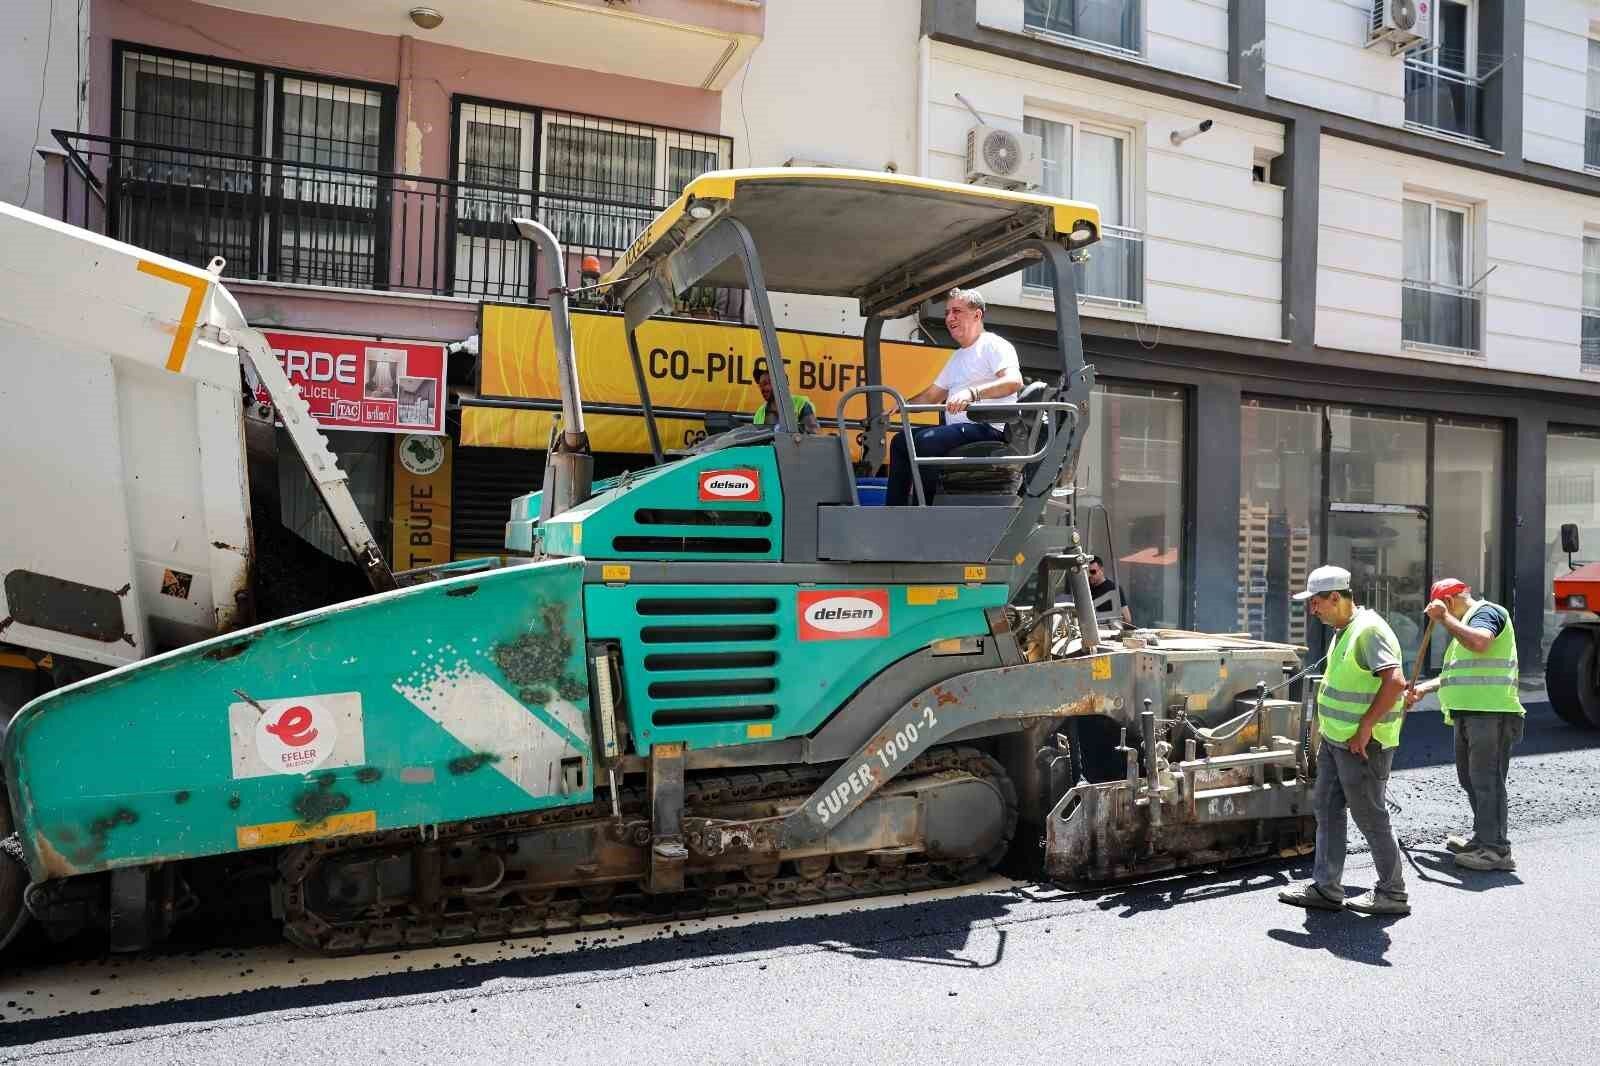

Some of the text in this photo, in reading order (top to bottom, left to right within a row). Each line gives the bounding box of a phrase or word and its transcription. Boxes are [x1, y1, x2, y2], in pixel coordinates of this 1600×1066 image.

[338, 405, 359, 417] TAC
[709, 480, 749, 490] delsan
[404, 485, 433, 546] BÜFE
[813, 607, 874, 621] delsan
[281, 749, 317, 762] EFELER
[816, 706, 938, 823] SUPER 1900-2
